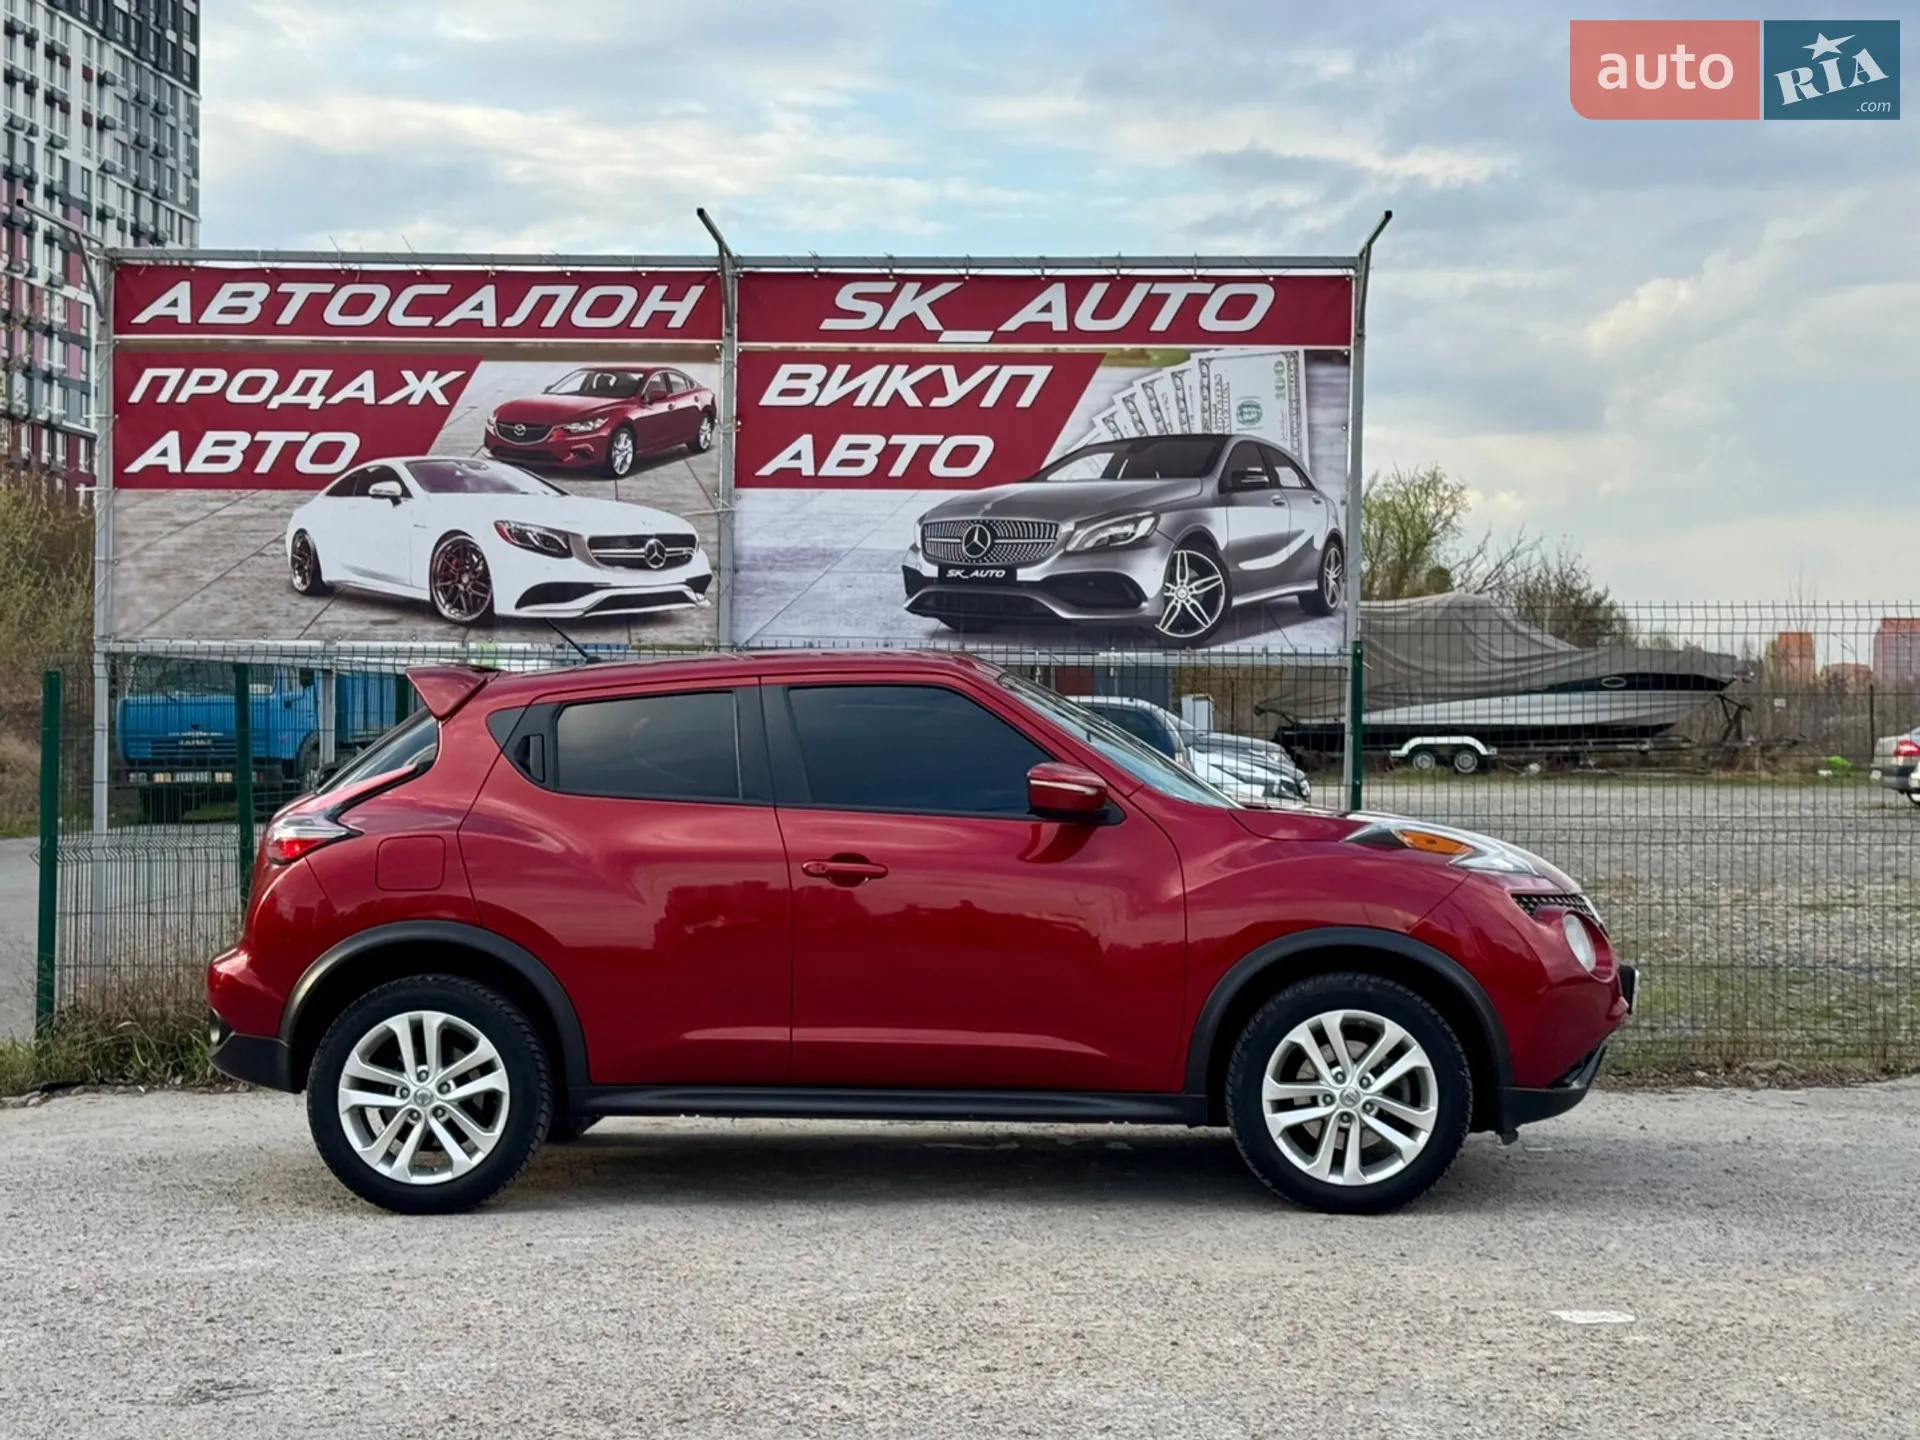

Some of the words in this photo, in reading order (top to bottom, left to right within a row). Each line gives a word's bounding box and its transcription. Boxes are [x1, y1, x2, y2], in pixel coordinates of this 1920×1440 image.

[130, 281, 706, 329] АВТОСАЛОН
[819, 281, 1275, 343] SK_AUTO
[128, 367, 467, 411] ПРОДАЖ
[758, 363, 1054, 408] ВИКУП
[123, 430, 361, 475] АВТО
[755, 433, 996, 478] АВТО
[946, 568, 1006, 579] SK_AUTO
